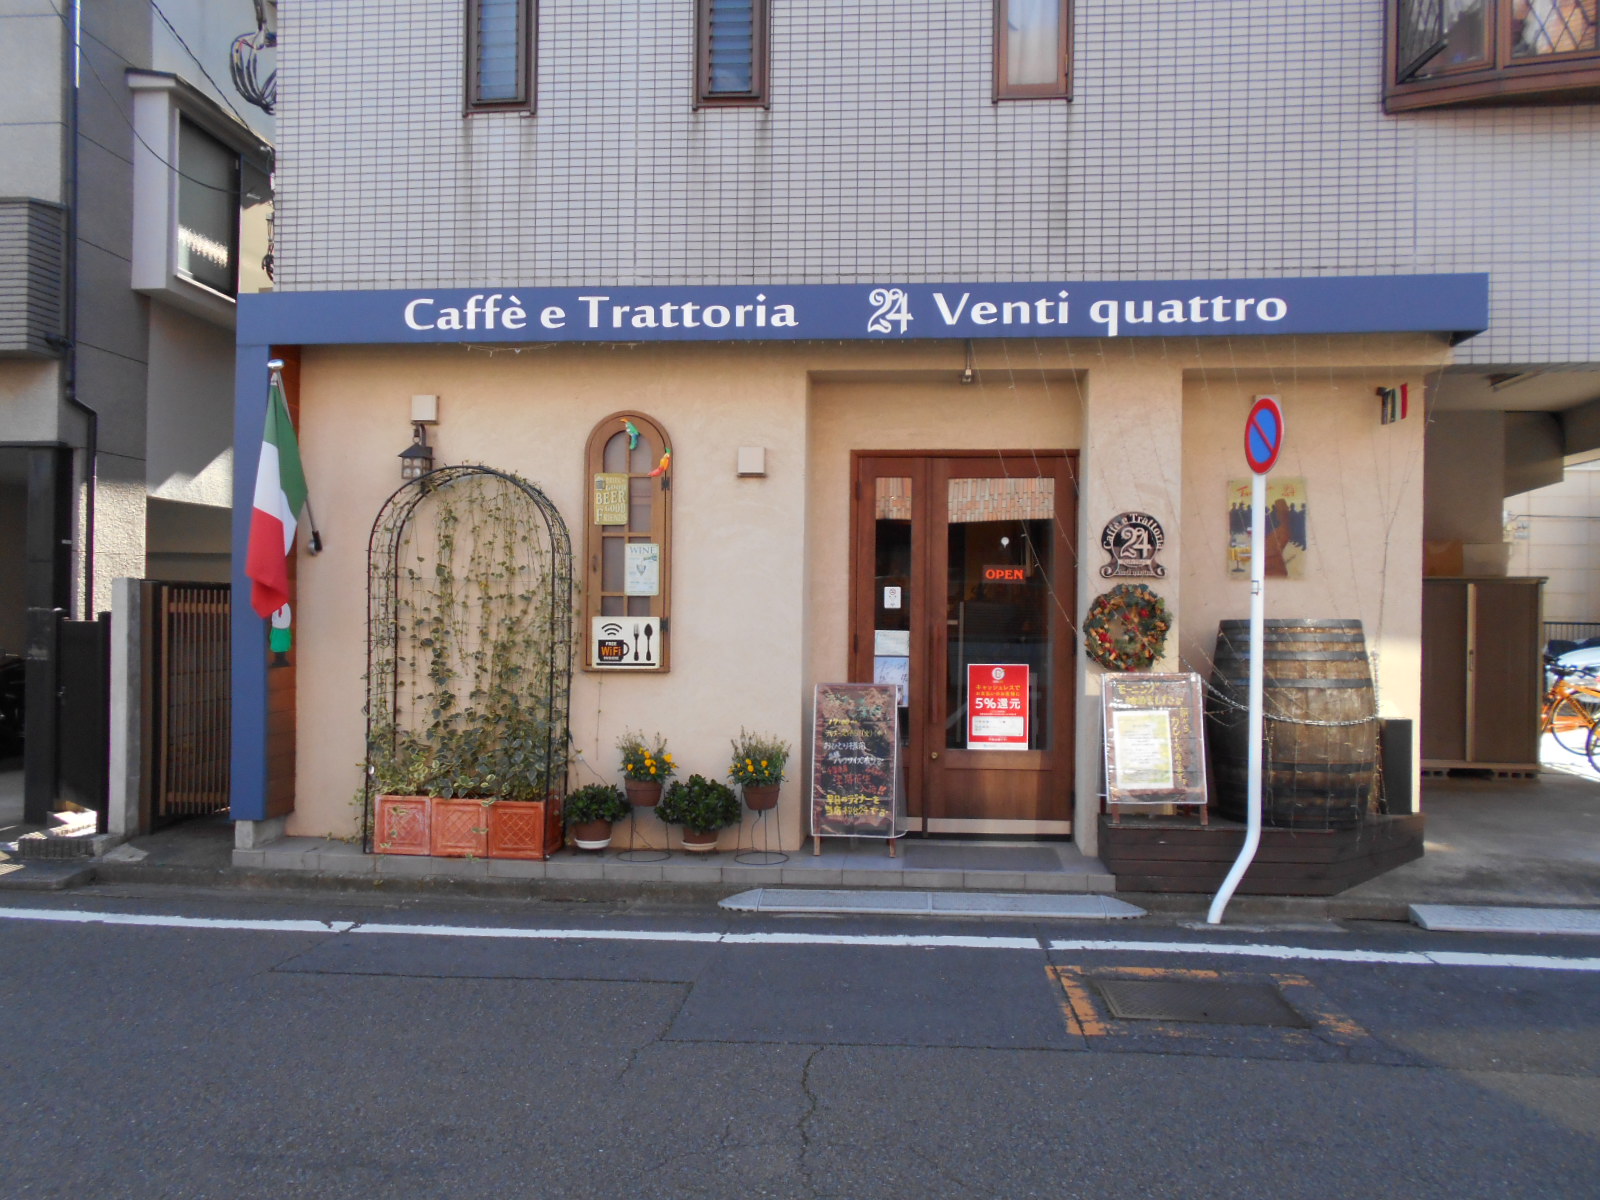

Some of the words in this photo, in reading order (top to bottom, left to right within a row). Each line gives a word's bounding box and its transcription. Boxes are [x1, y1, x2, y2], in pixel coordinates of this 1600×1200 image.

[404, 294, 527, 330] Caffè
[540, 305, 566, 329] e
[578, 293, 799, 329] Trattoria
[867, 288, 914, 334] 24
[932, 290, 1069, 325] Venti
[1089, 295, 1288, 337] quattro
[596, 490, 625, 504] BEER
[605, 503, 626, 513] GOOD
[1129, 513, 1164, 550] Trattoria
[1120, 527, 1152, 558] 24
[629, 546, 655, 555] WINE
[985, 569, 1024, 580] OPEN
[600, 646, 622, 656] WiFi
[975, 697, 1021, 709] 5%還元
